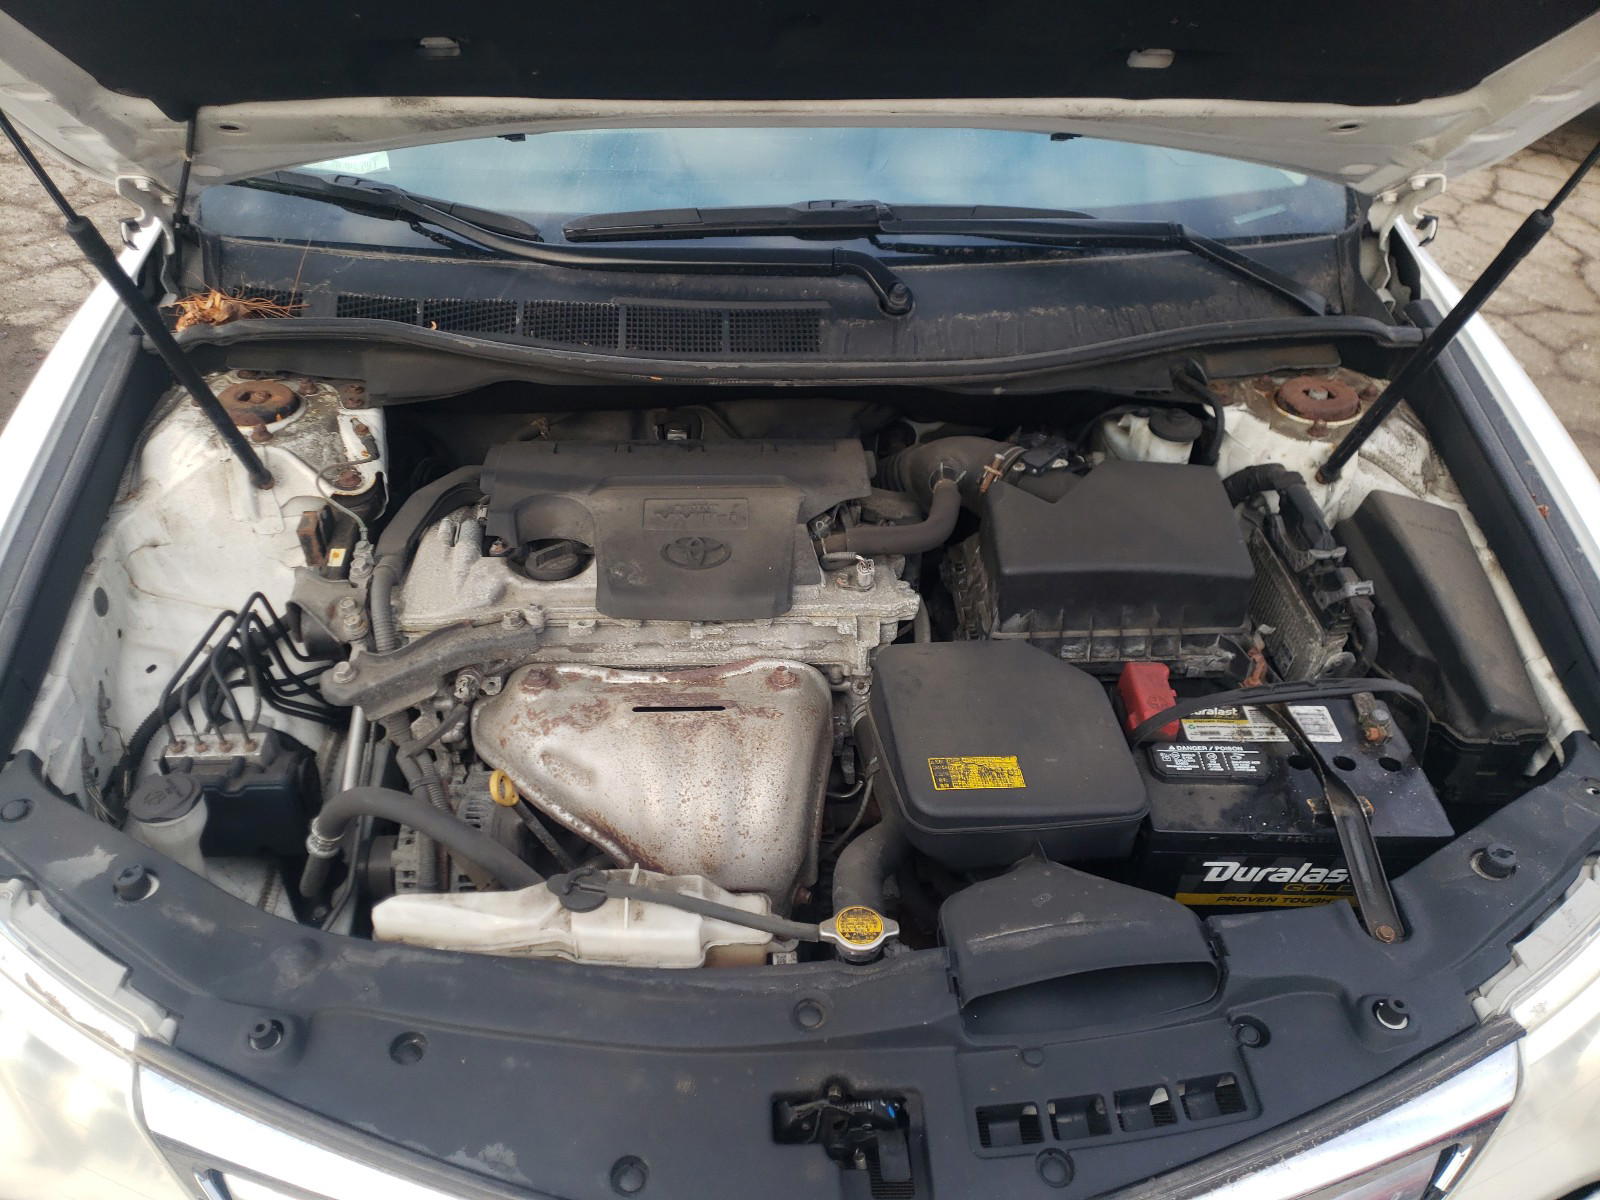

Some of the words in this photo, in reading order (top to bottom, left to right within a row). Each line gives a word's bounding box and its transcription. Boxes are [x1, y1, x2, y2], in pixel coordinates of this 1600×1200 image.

[1190, 707, 1238, 716] uralast
[1202, 861, 1351, 883] Duralas
[1282, 897, 1332, 905] TOUGH
